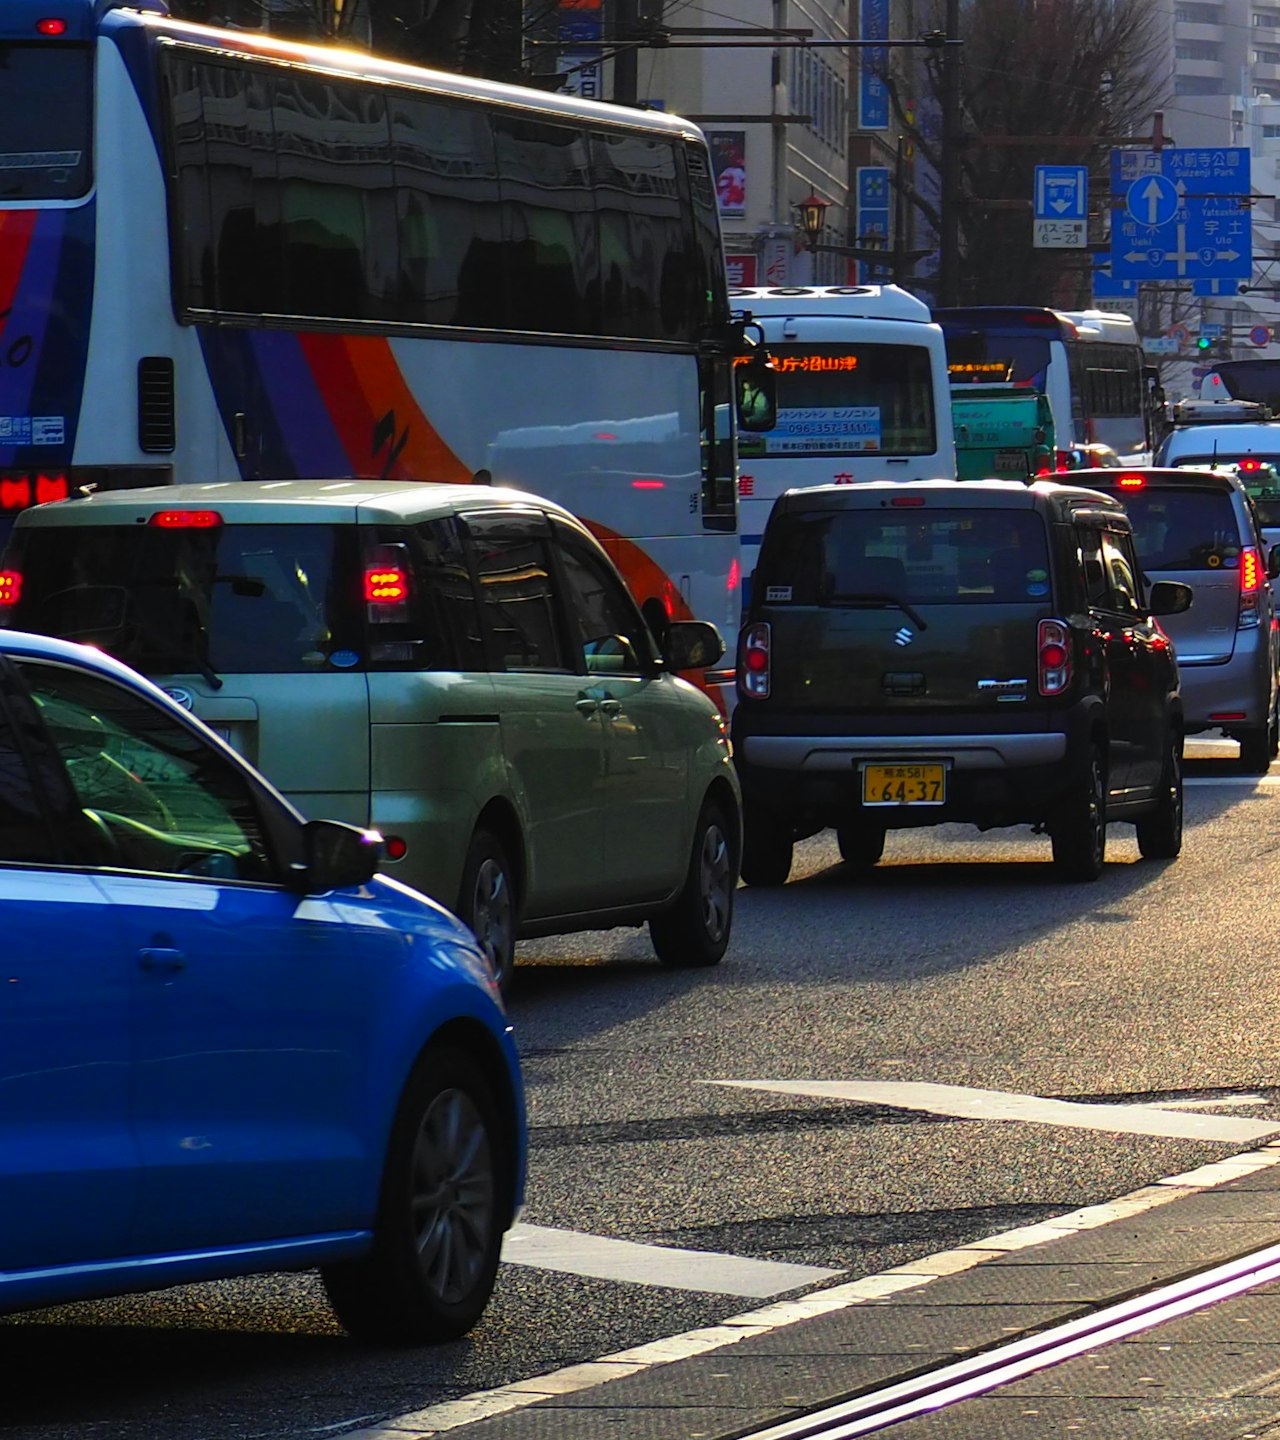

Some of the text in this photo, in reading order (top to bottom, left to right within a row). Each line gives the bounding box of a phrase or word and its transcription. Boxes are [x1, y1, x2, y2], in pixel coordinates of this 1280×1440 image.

[1170, 152, 1240, 167] 水前寺公園
[1175, 169, 1211, 177] Suizenji
[1204, 221, 1243, 235] 宇土
[1152, 250, 1211, 261] 3 3
[882, 781, 941, 801] 64-37
